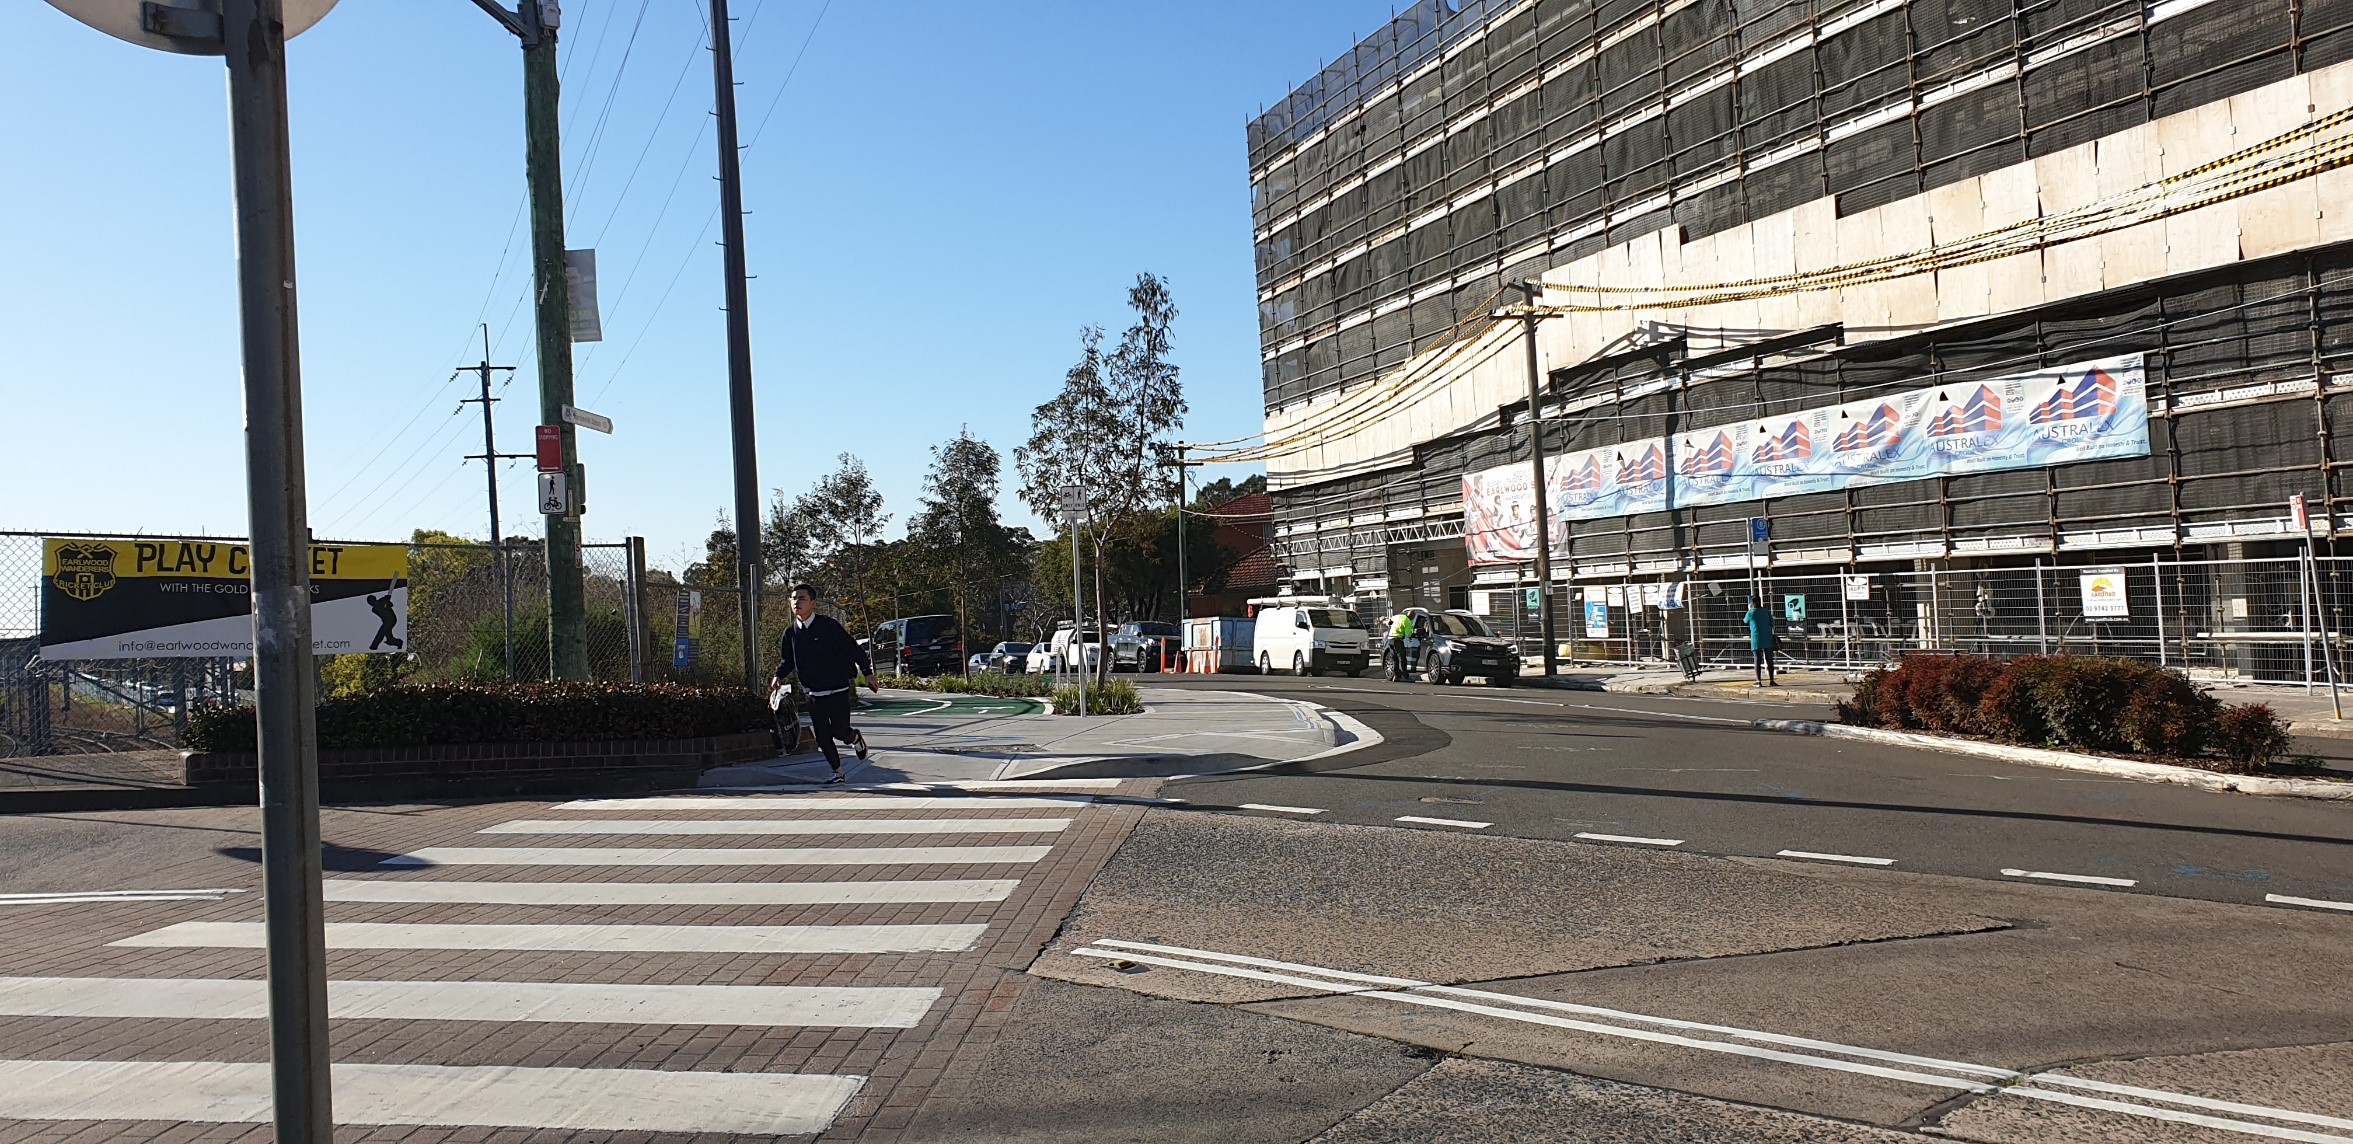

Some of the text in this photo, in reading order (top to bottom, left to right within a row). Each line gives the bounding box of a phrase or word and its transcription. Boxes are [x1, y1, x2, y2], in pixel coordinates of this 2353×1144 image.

[2032, 420, 2115, 441] AUSTRALEX
[1929, 434, 2000, 453] AUSTRALEX
[1834, 446, 1902, 467] AUSTRALEX
[1486, 482, 1528, 496] EARLWOOD
[61, 558, 109, 567] EARLWOOD
[134, 543, 216, 573] PLAY
[60, 565, 110, 573] WANDERERS
[53, 578, 115, 589] CRICKET CLUB
[159, 583, 248, 594] WITH THE GOLD
